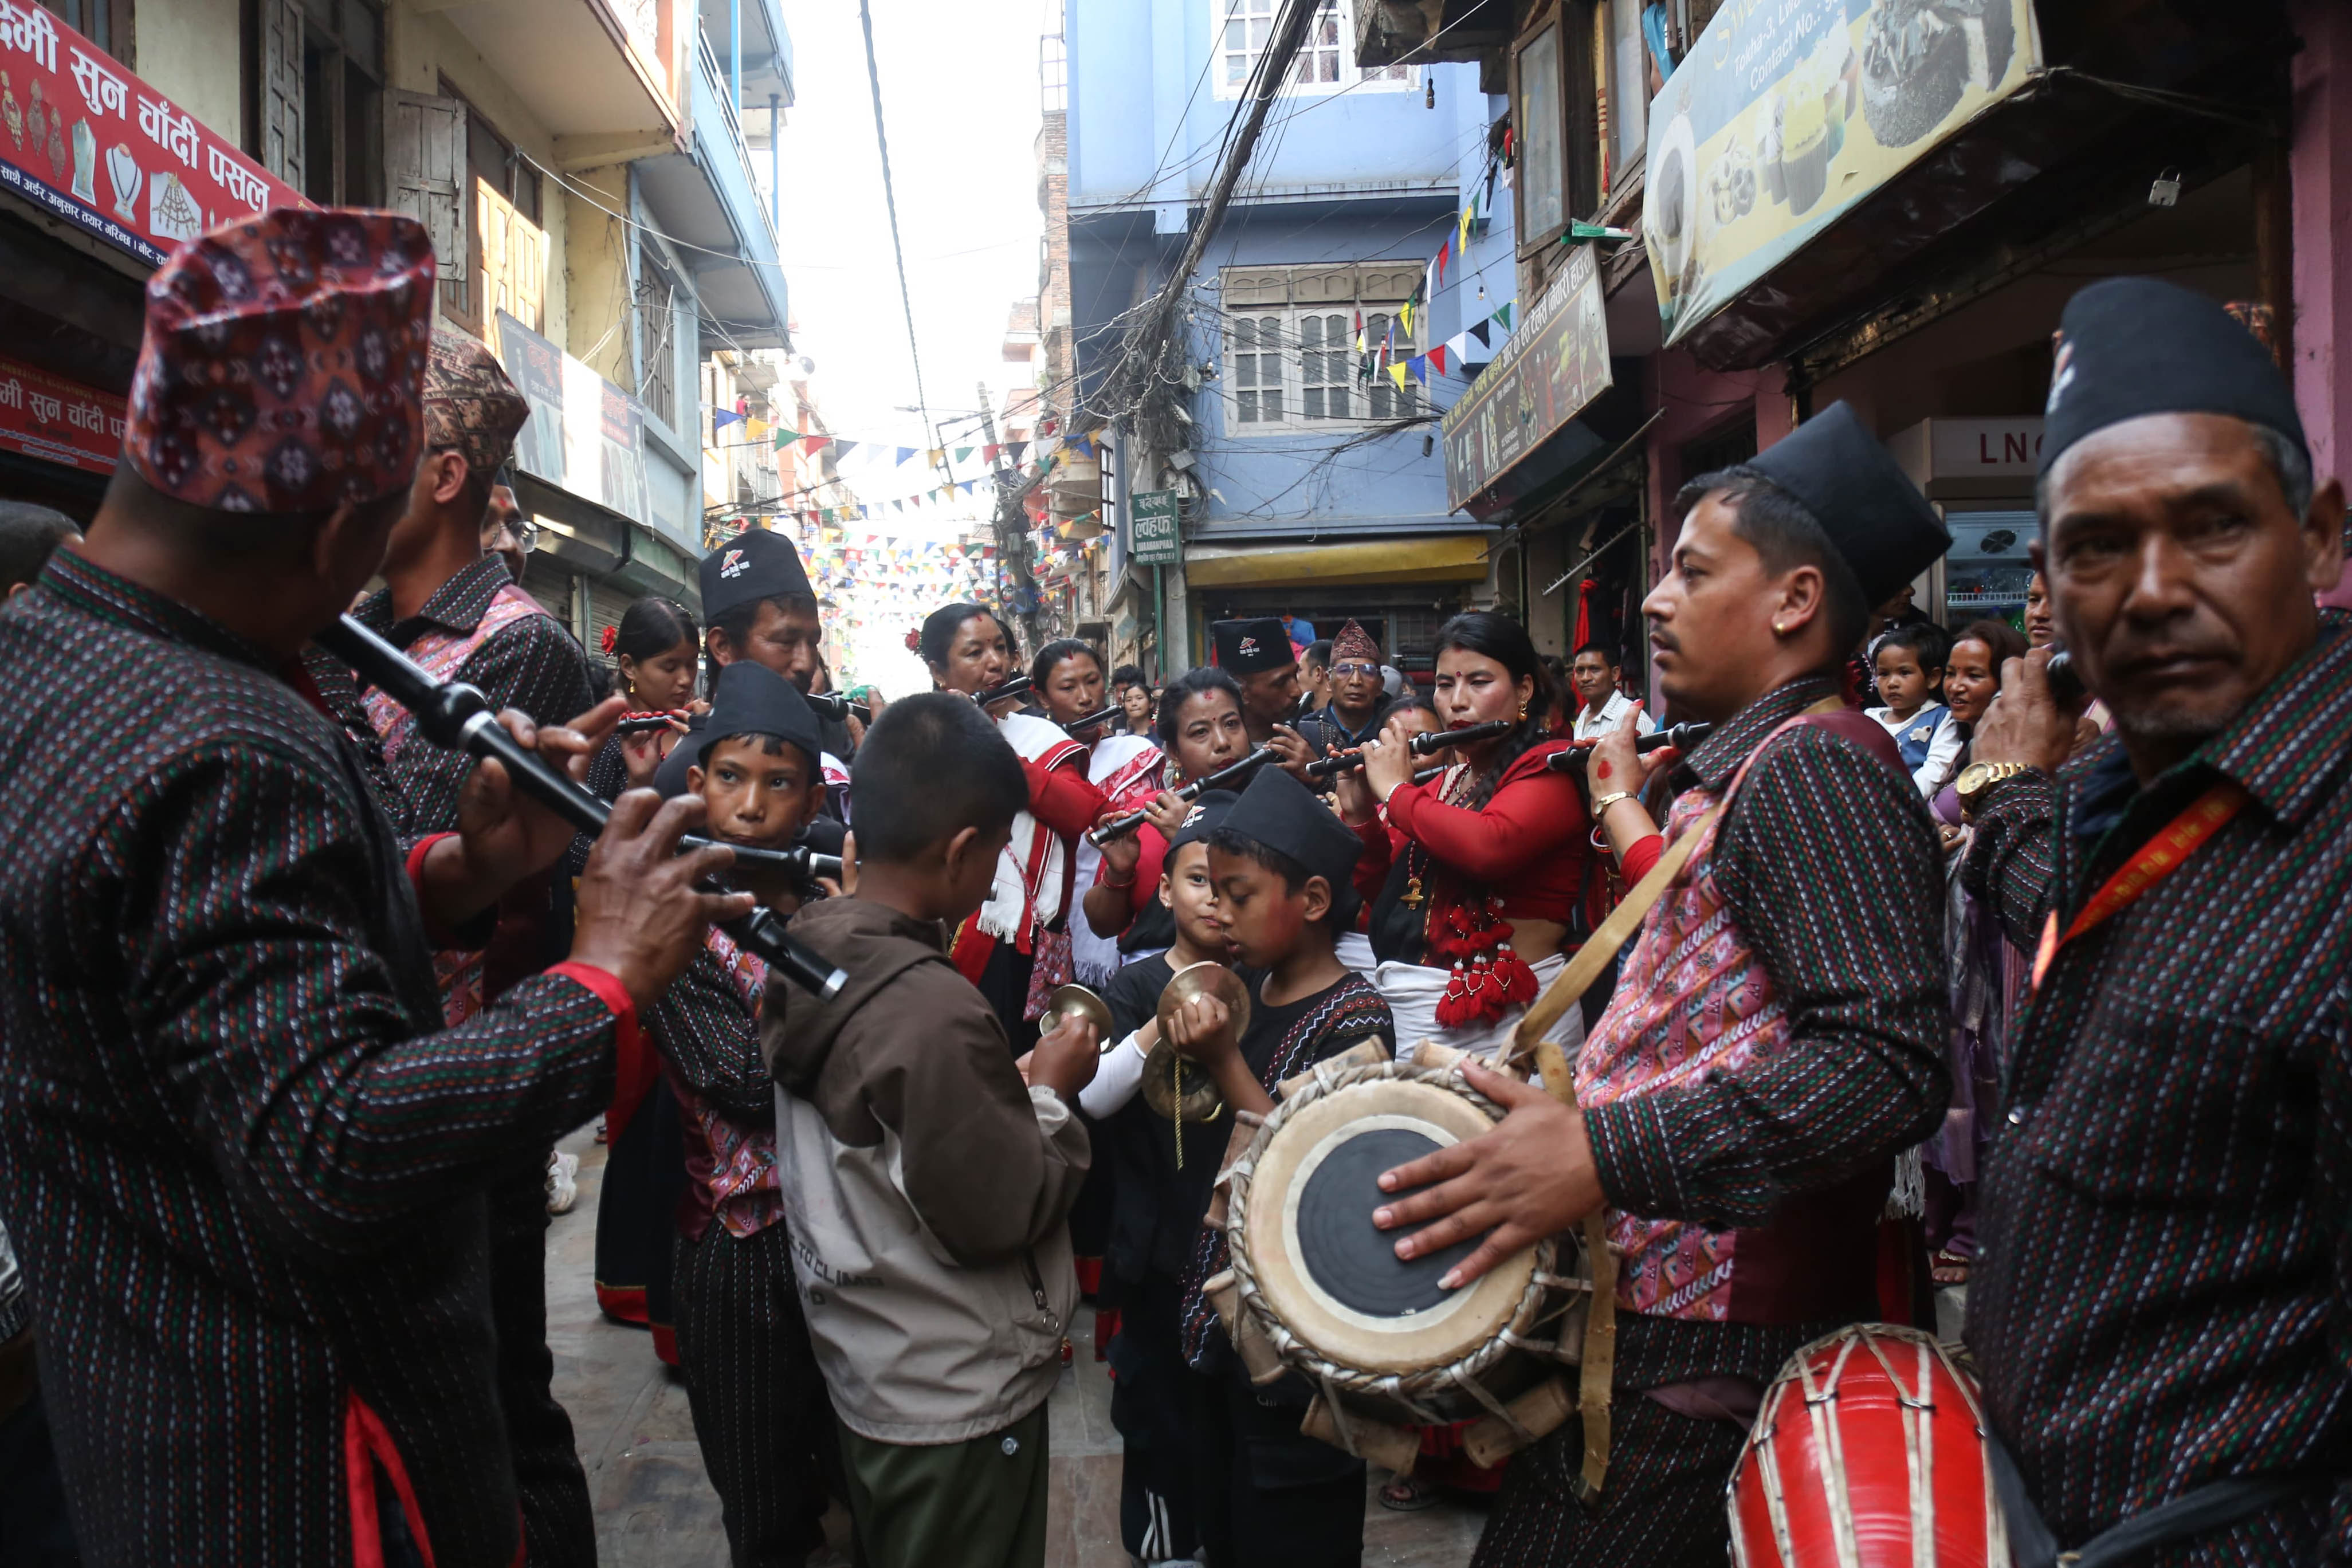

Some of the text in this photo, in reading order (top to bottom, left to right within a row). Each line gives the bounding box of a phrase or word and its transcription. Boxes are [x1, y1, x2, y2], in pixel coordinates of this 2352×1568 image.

[1750, 32, 1793, 91] Contact
[70, 46, 128, 120] सुन
[138, 94, 200, 170] चाँदी
[207, 144, 270, 215] पसल
[1, 165, 21, 186] साथै
[48, 192, 80, 219] अनुसार
[82, 211, 103, 231] तयार
[105, 223, 131, 247] गरिन्छ
[29, 391, 61, 423] सुन
[67, 400, 104, 434] चाँदी
